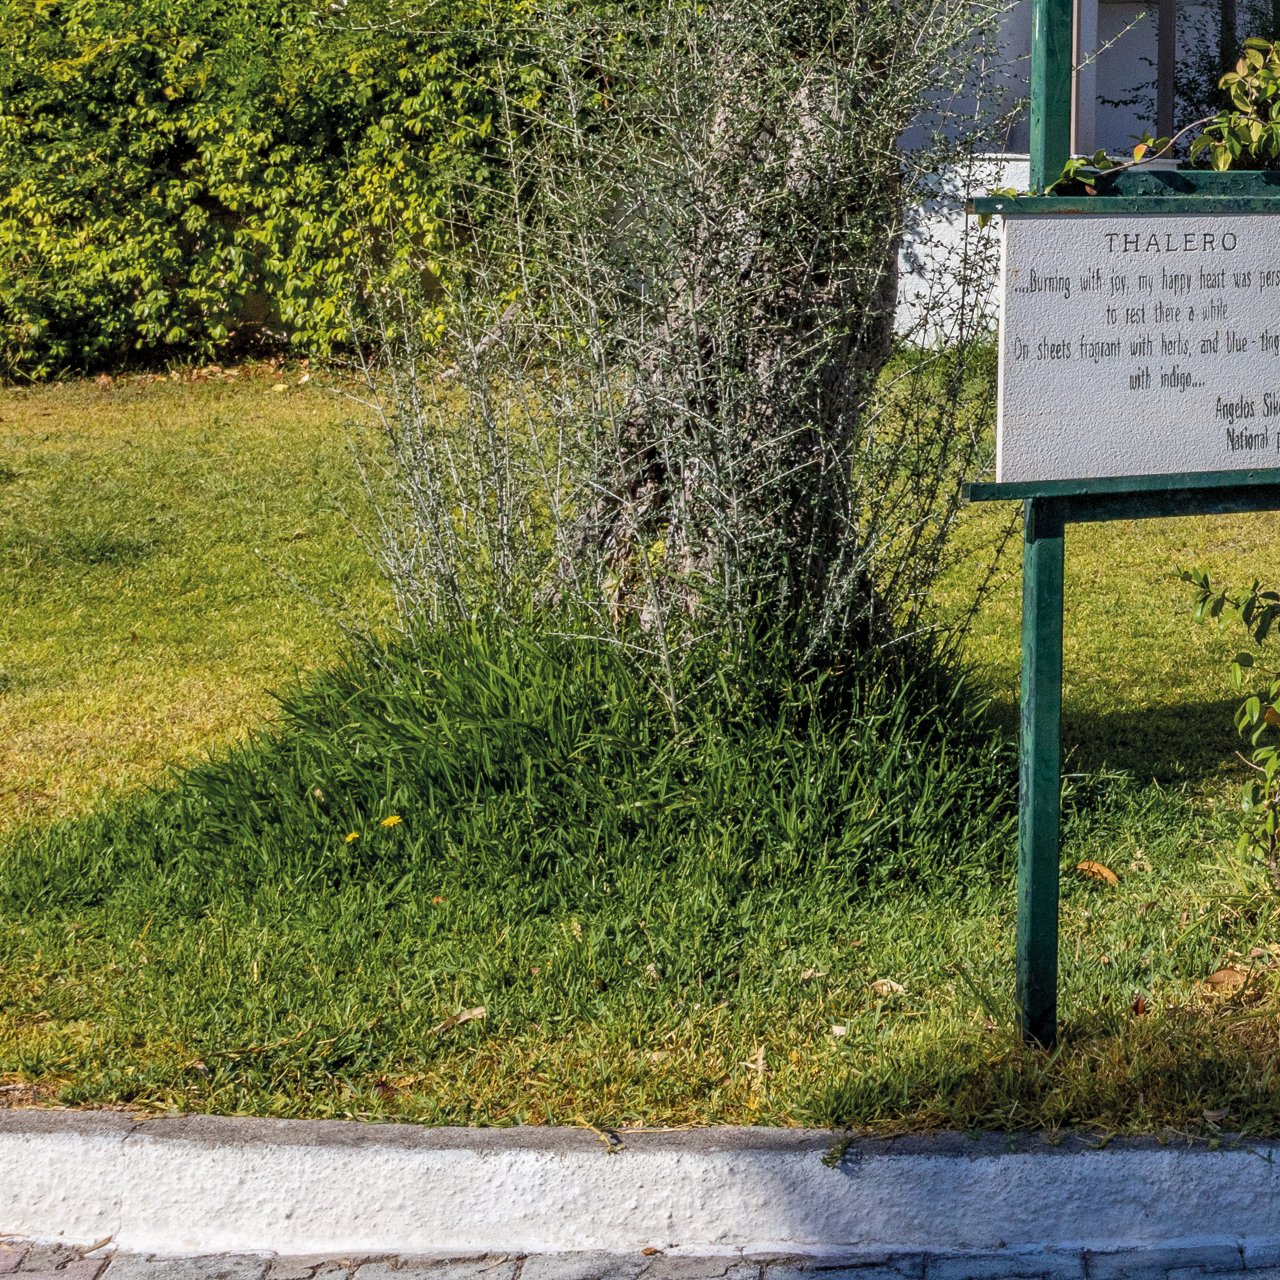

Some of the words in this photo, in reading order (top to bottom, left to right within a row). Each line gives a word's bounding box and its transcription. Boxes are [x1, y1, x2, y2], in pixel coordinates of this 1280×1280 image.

[1104, 232, 1237, 253] THALERO
[1080, 266, 1101, 292] with
[1110, 267, 1130, 297] joy,
[1138, 274, 1154, 296] my
[1162, 265, 1192, 296] happy
[1200, 264, 1226, 290] heart
[1232, 271, 1252, 288] was
[1106, 304, 1117, 325] to
[1125, 304, 1145, 325] rest
[1154, 300, 1181, 323] there
[1188, 306, 1195, 322] a
[1014, 335, 1029, 360] On
[1037, 336, 1072, 361] sheets
[1080, 334, 1121, 364] fragrant
[1129, 333, 1153, 357] with
[1161, 332, 1192, 358] herbs,
[1200, 330, 1219, 355] and
[1129, 366, 1151, 391] with
[1215, 394, 1255, 424] Angelos
[1226, 425, 1268, 452] National
